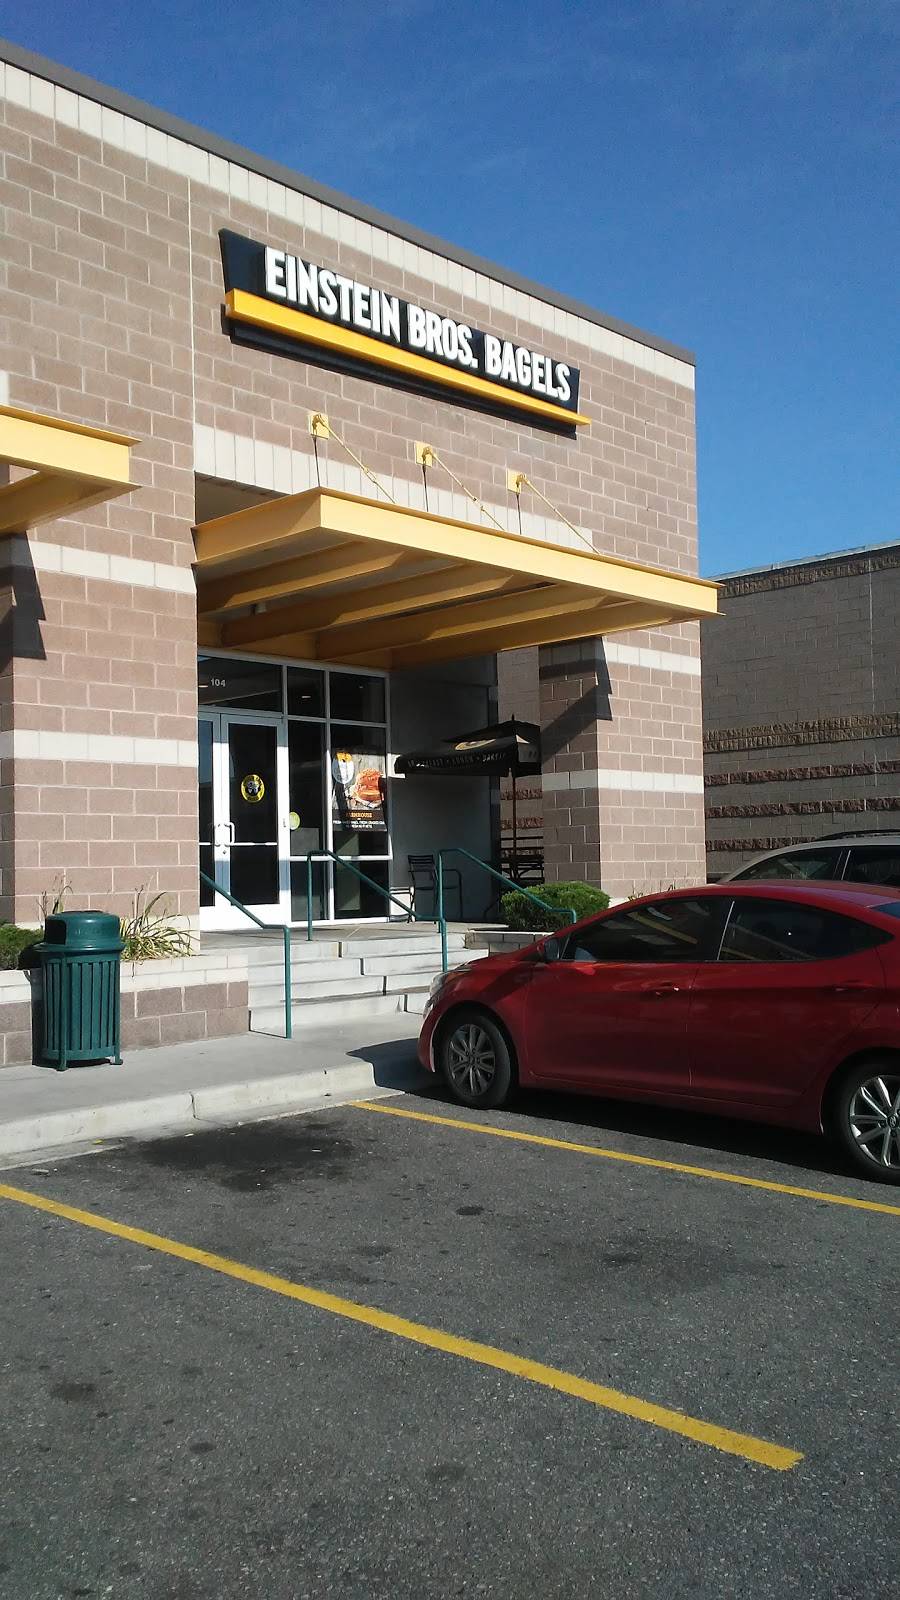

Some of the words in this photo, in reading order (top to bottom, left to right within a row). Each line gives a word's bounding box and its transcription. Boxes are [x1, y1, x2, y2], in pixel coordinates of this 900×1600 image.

[264, 246, 401, 343] EINSTEIN
[407, 303, 478, 369] BROS.
[484, 334, 571, 401] BAGELS
[210, 677, 226, 688] 104
